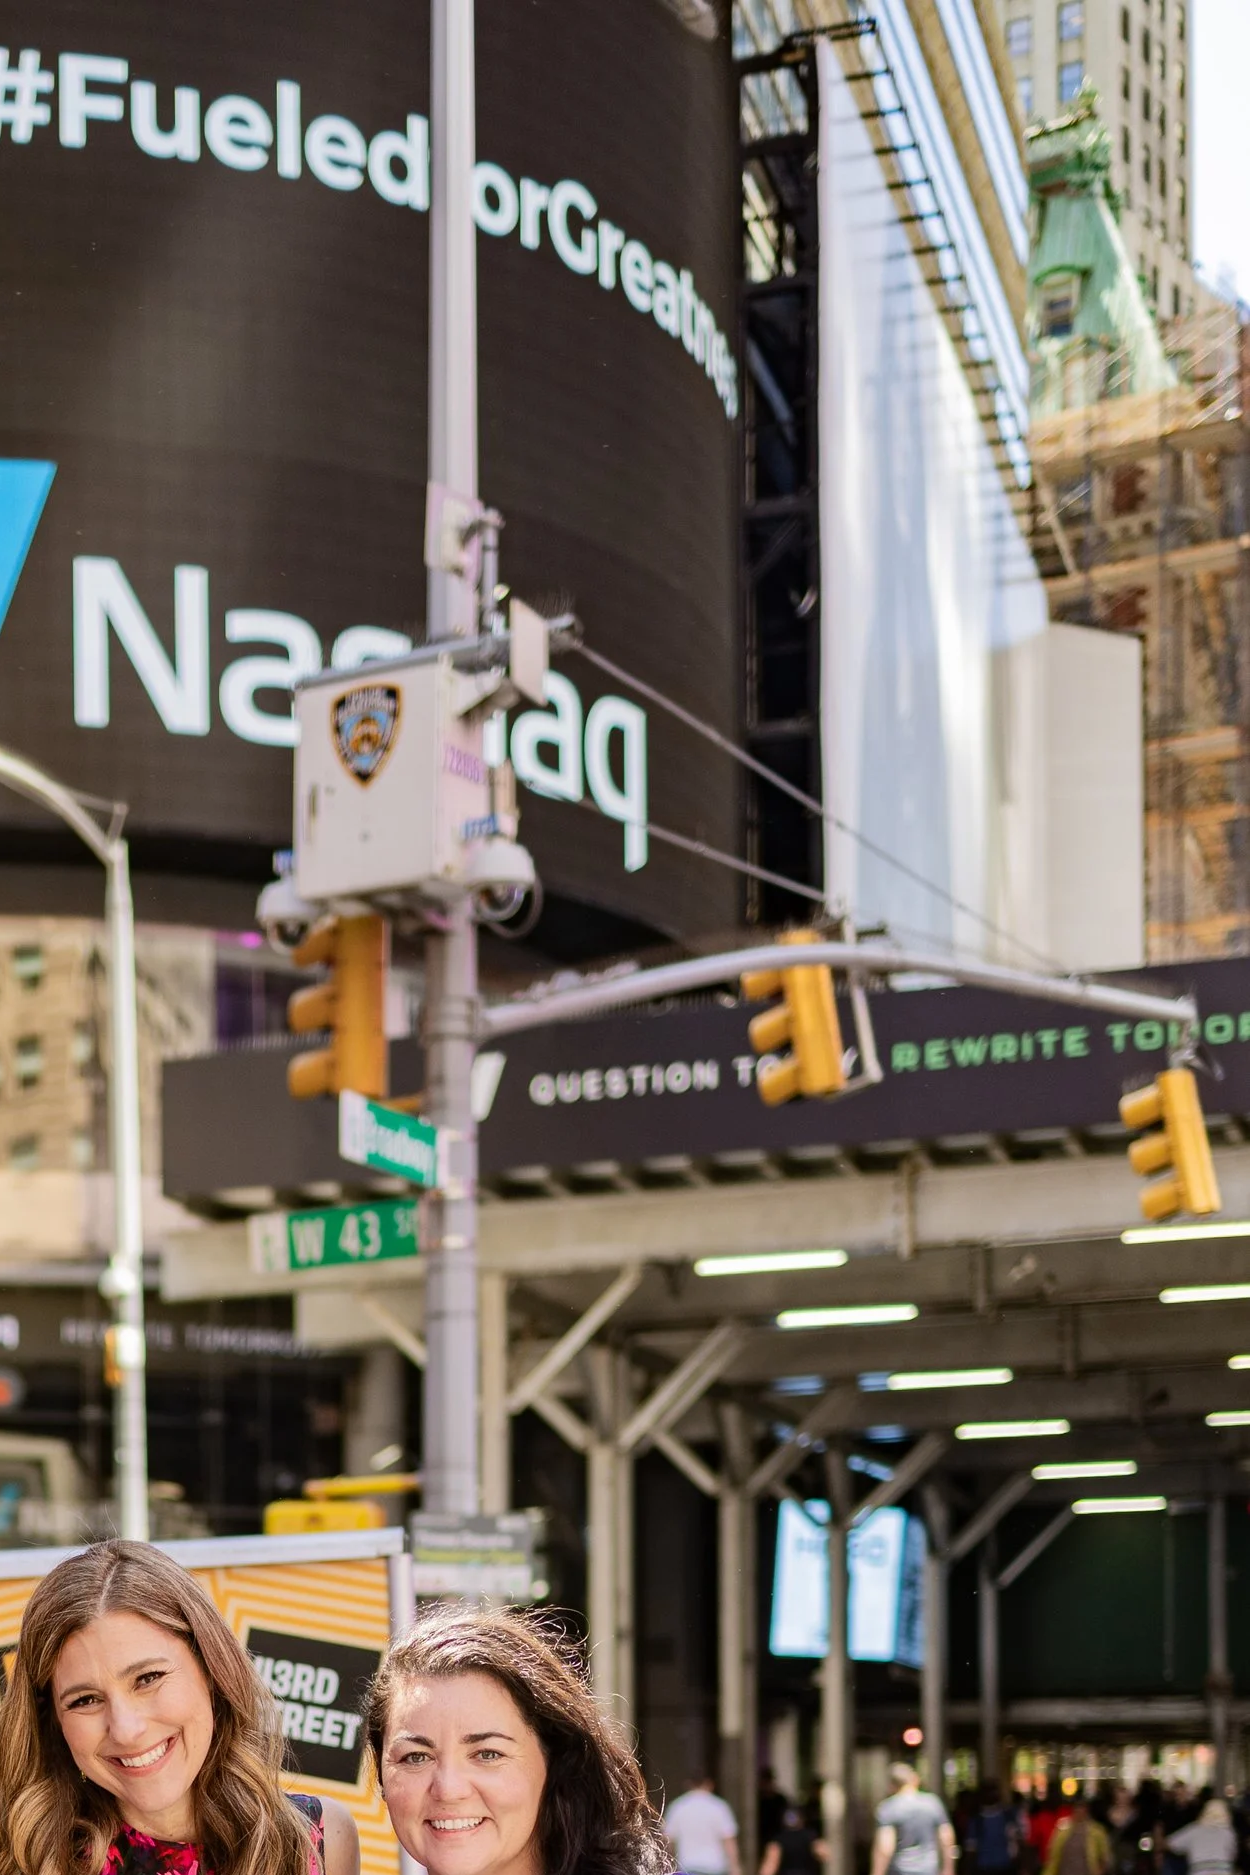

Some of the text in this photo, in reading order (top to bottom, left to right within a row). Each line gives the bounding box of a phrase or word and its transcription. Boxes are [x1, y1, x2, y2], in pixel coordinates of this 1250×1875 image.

[72, 554, 648, 873] Naaq
[528, 1058, 720, 1107] QUESTION
[891, 1025, 1091, 1074] REWRITE
[291, 1215, 326, 1264] W
[338, 1209, 382, 1259] 43
